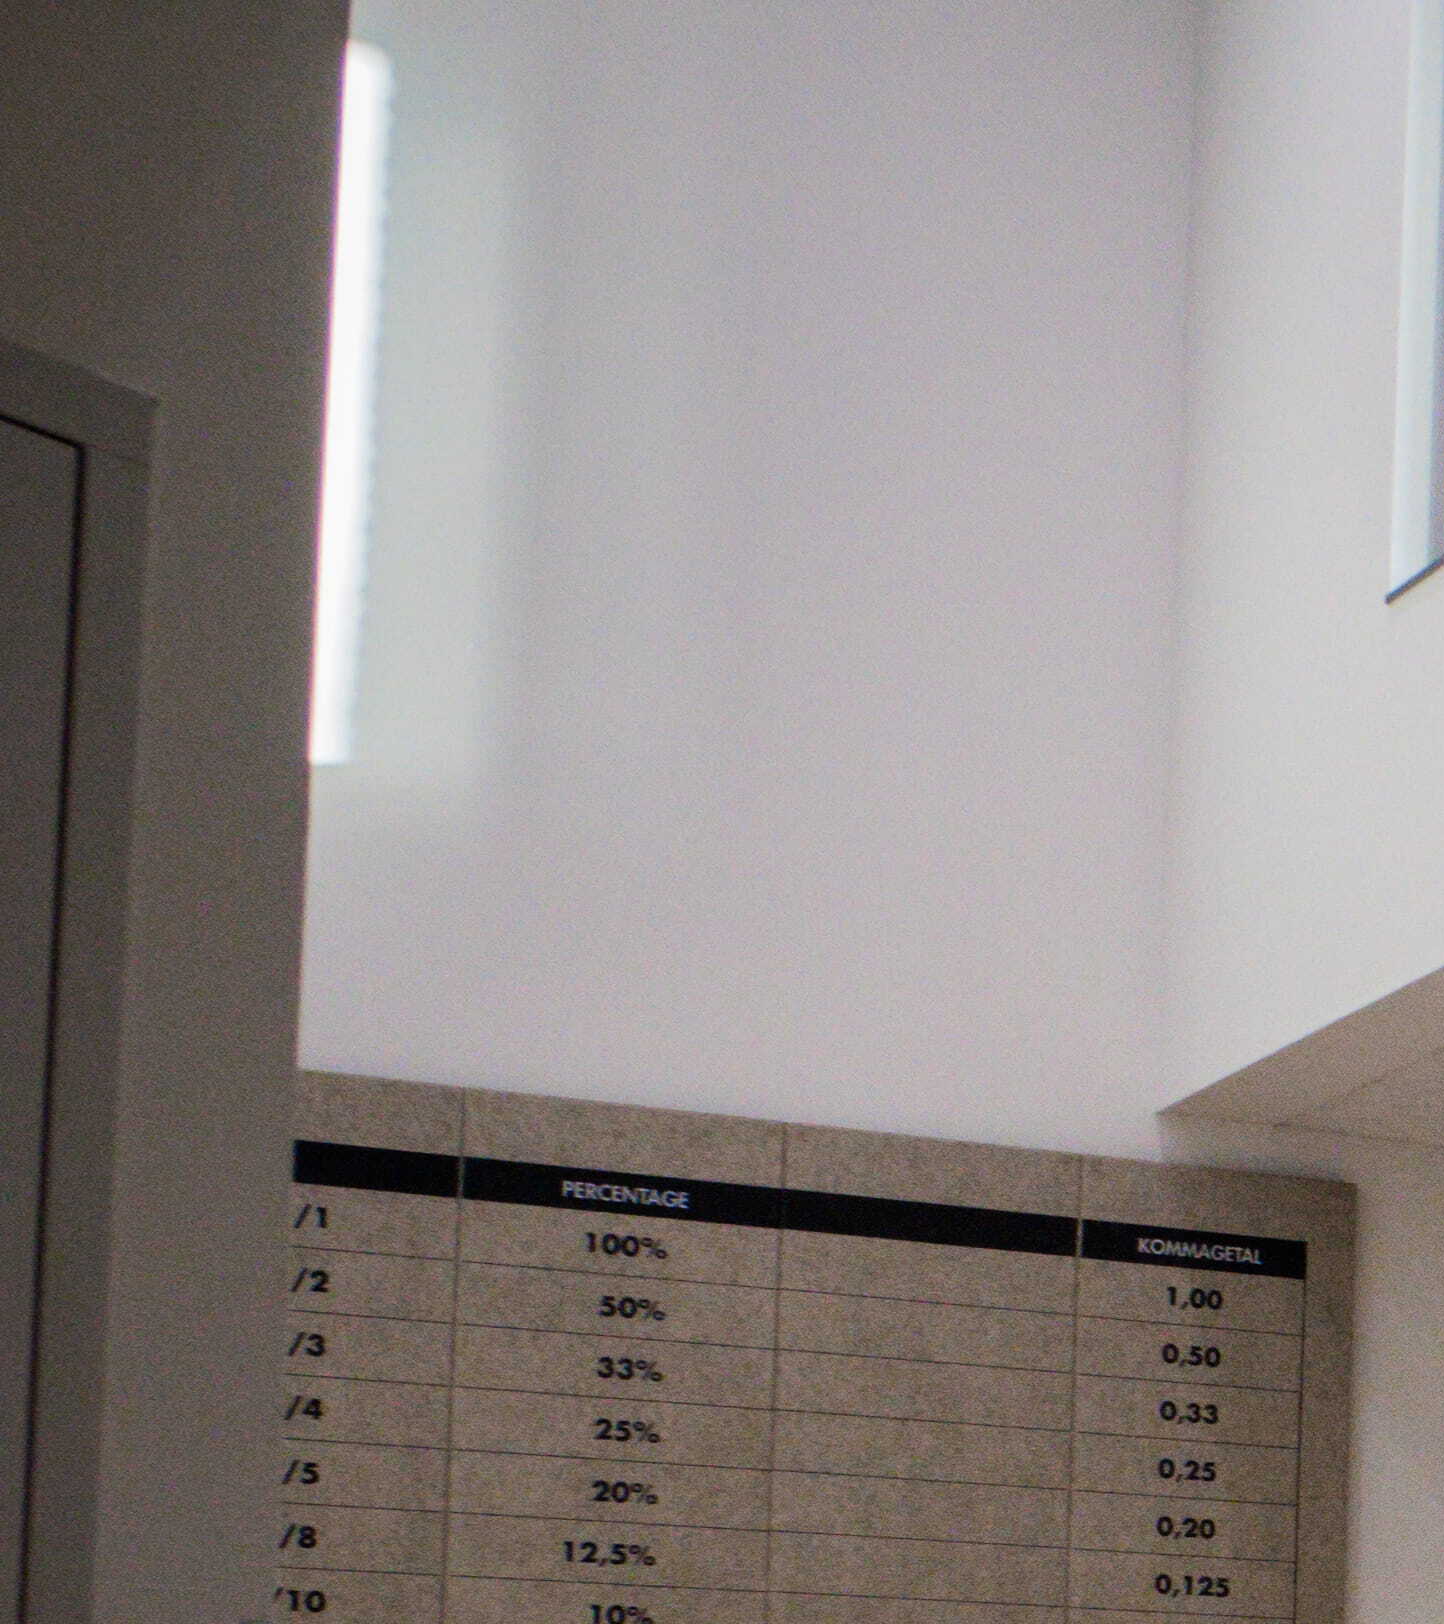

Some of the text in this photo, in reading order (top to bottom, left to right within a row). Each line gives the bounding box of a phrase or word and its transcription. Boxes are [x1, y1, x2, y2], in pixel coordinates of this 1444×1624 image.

[562, 1180, 1263, 1265] PERCENTAGE KOMMAGETAL
[586, 1232, 667, 1259] 100%
[1168, 1286, 1224, 1311] 1,00
[599, 1295, 665, 1321] 50%
[1162, 1343, 1222, 1368] 0,50
[597, 1356, 663, 1382] 33%
[1159, 1400, 1219, 1425] 0,33
[595, 1418, 660, 1444] 25%
[1157, 1458, 1217, 1483] 0,25
[592, 1479, 657, 1505] 20%
[1156, 1515, 1216, 1540] 0,20
[564, 1540, 656, 1567] 12,5%
[1154, 1573, 1230, 1598] 0,125
